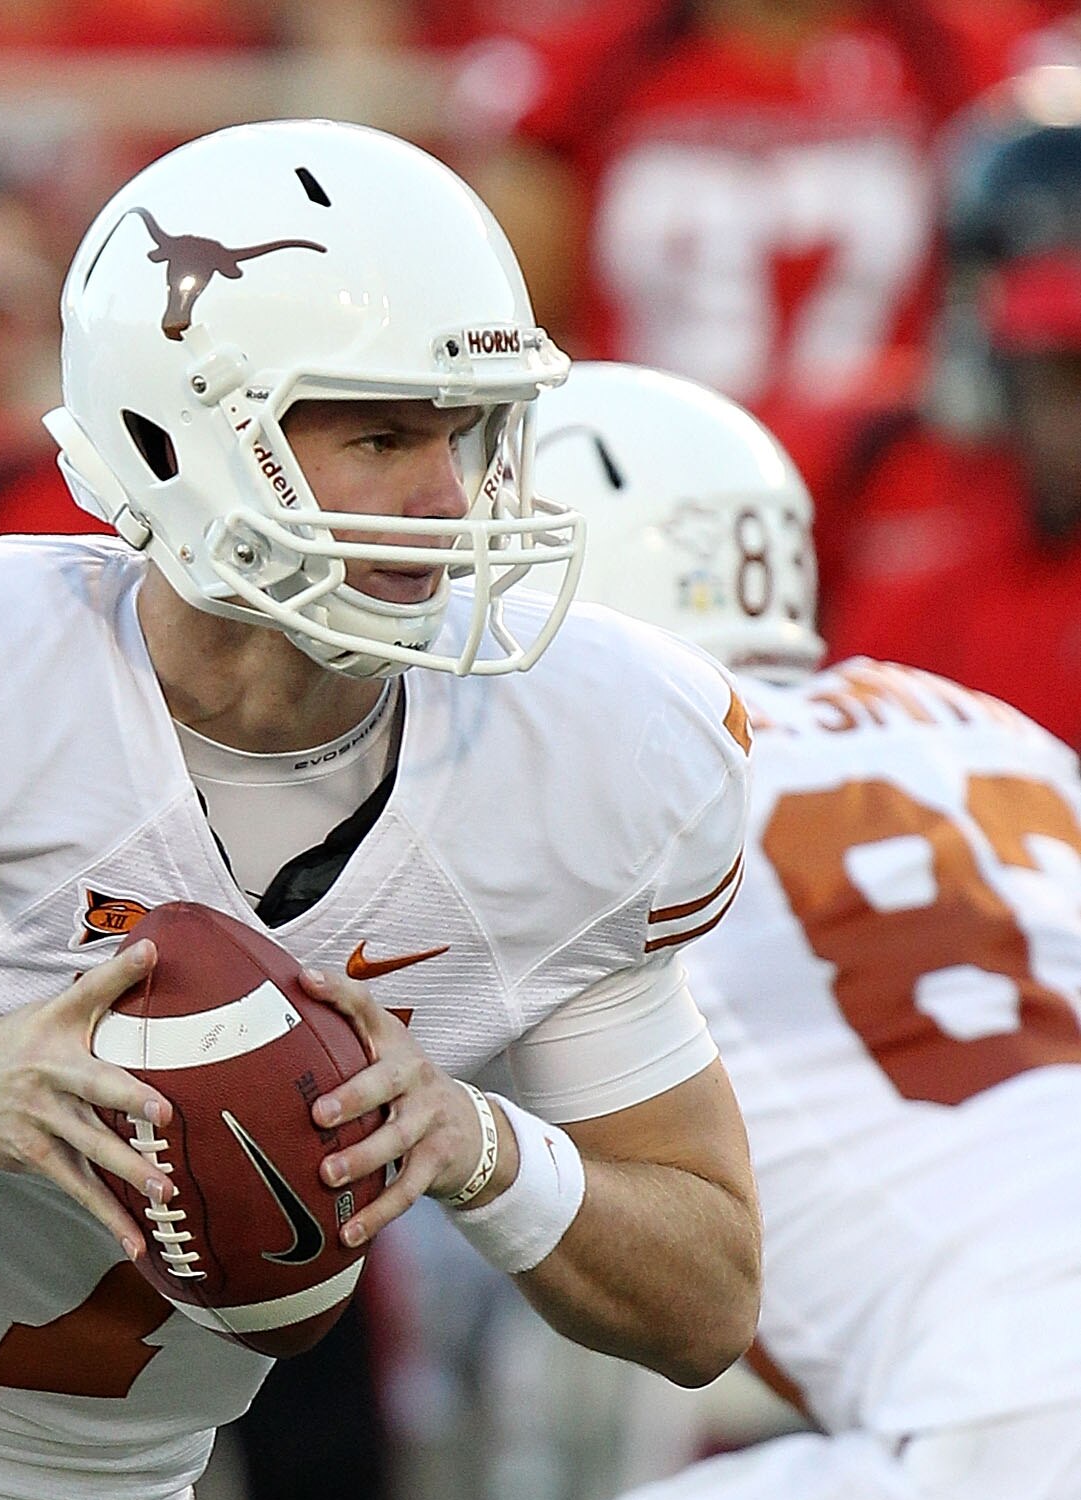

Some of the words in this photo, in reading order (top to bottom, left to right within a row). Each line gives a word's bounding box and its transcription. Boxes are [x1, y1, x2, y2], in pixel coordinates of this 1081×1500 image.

[468, 329, 520, 354] HORNS
[245, 389, 269, 400] Ridd
[734, 508, 816, 619] 83
[99, 912, 129, 930] XII
[448, 1126, 496, 1202] TEXAS
